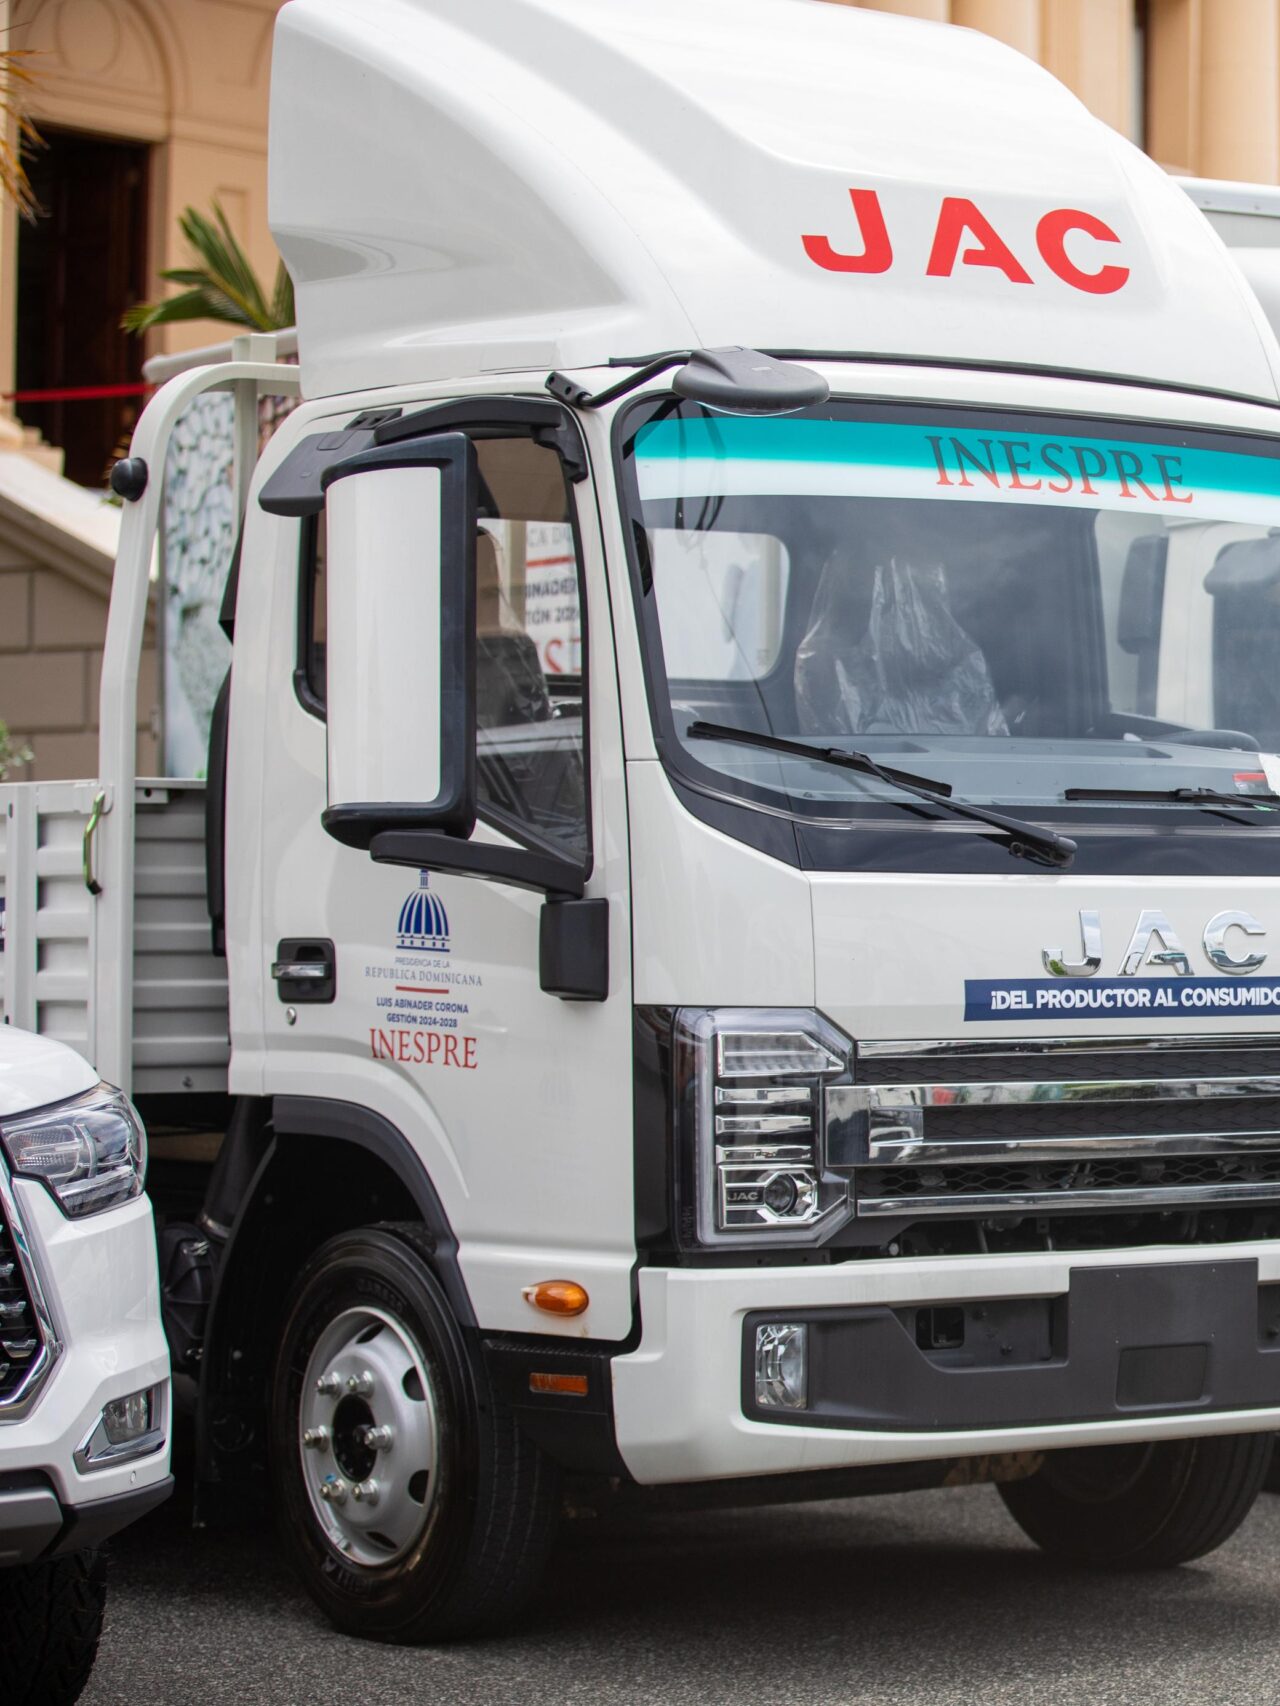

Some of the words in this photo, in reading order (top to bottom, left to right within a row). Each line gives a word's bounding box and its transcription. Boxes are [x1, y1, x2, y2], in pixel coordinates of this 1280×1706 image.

[801, 188, 1130, 294] JAC
[925, 436, 1193, 503] INESPRE
[1041, 909, 1268, 977] JAC
[419, 971, 483, 986] DOMINICANA
[376, 997, 393, 1008] LUIS
[435, 1002, 469, 1014] CORONA
[991, 989, 1034, 1010] ¡DEL
[1036, 989, 1151, 1009] PRODUCTOR
[1153, 988, 1178, 1007] AL
[387, 1012, 418, 1025] GESTIÓN
[419, 1016, 458, 1028] 2024-2028
[369, 1028, 478, 1070] INESPRE
[728, 1192, 758, 1201] JAC
